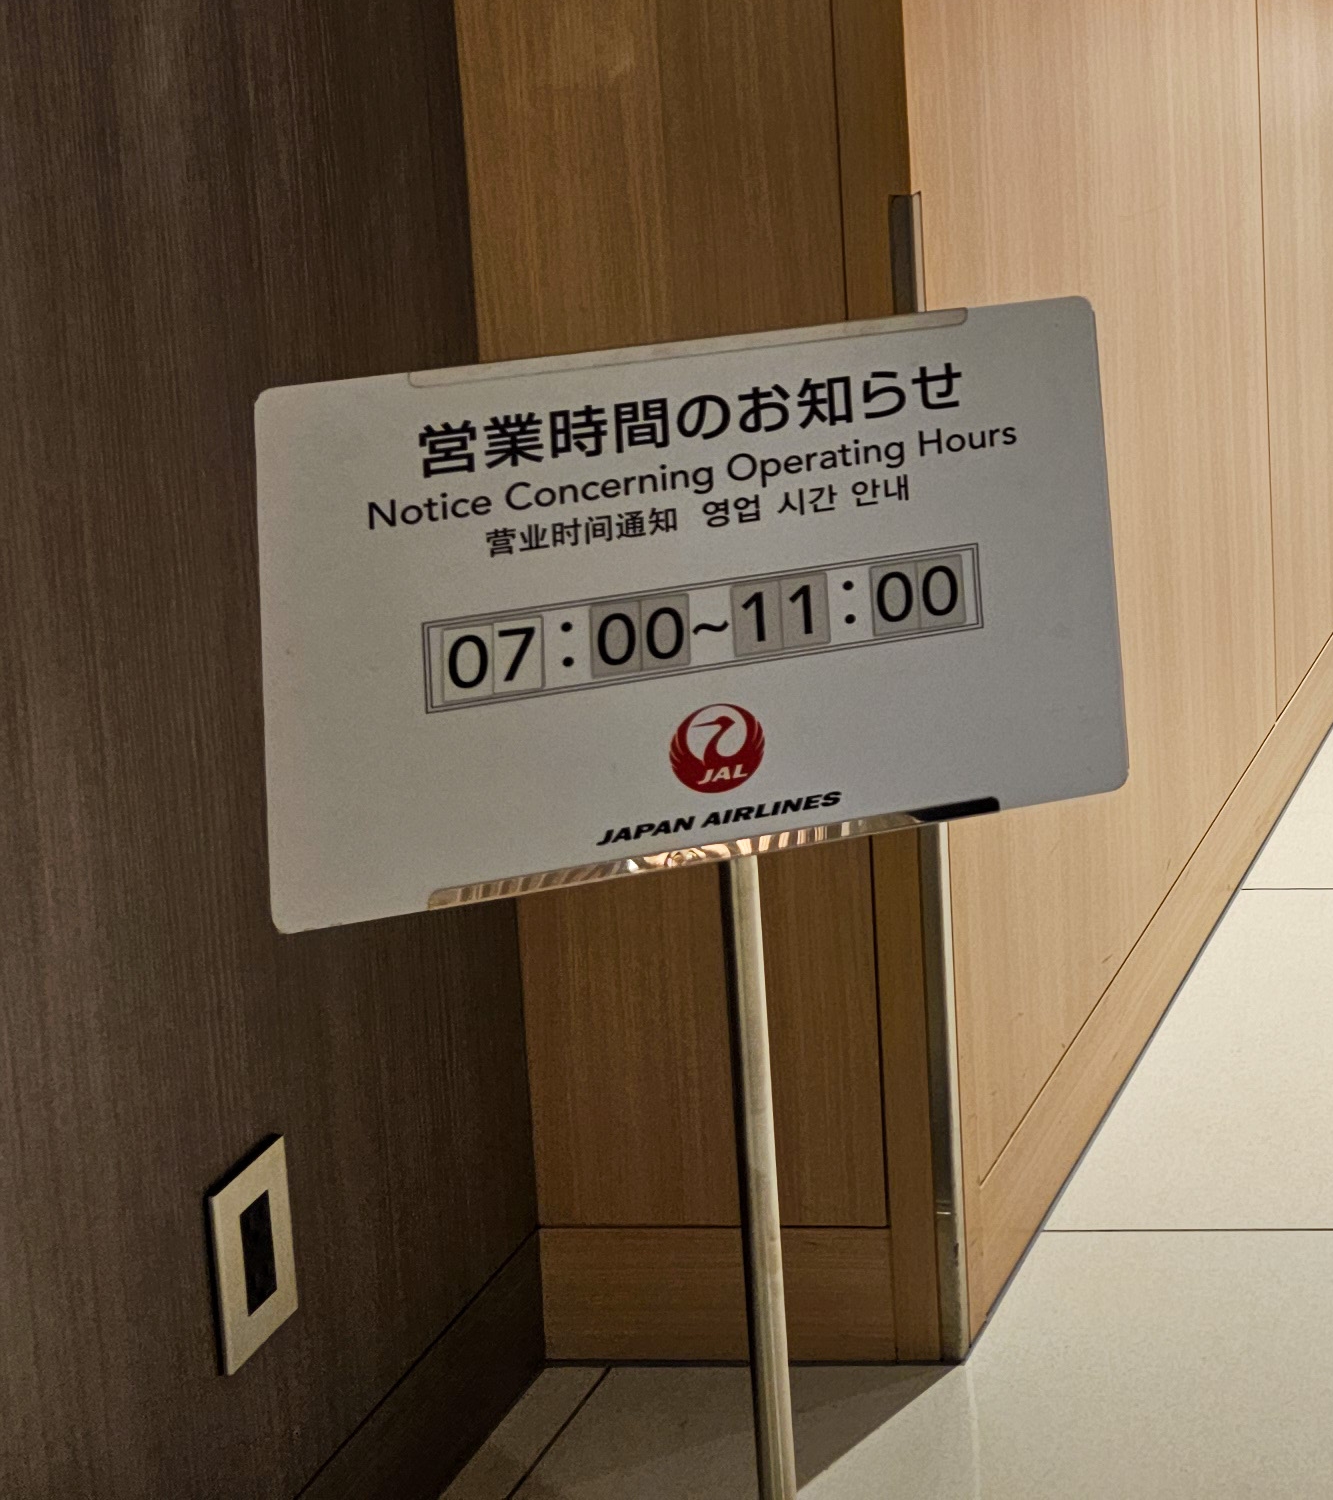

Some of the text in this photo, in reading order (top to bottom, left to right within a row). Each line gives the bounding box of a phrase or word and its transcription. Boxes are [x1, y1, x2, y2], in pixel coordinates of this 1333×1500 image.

[418, 362, 962, 479] 営業時間のお知らせ
[367, 426, 1017, 531] Notice Concerning Operating Hours
[702, 474, 910, 528] 영업 시간 안내
[486, 507, 679, 558] 营业时间通知
[697, 764, 748, 785] JAL
[596, 790, 842, 846] JAPAN AIRLINES
